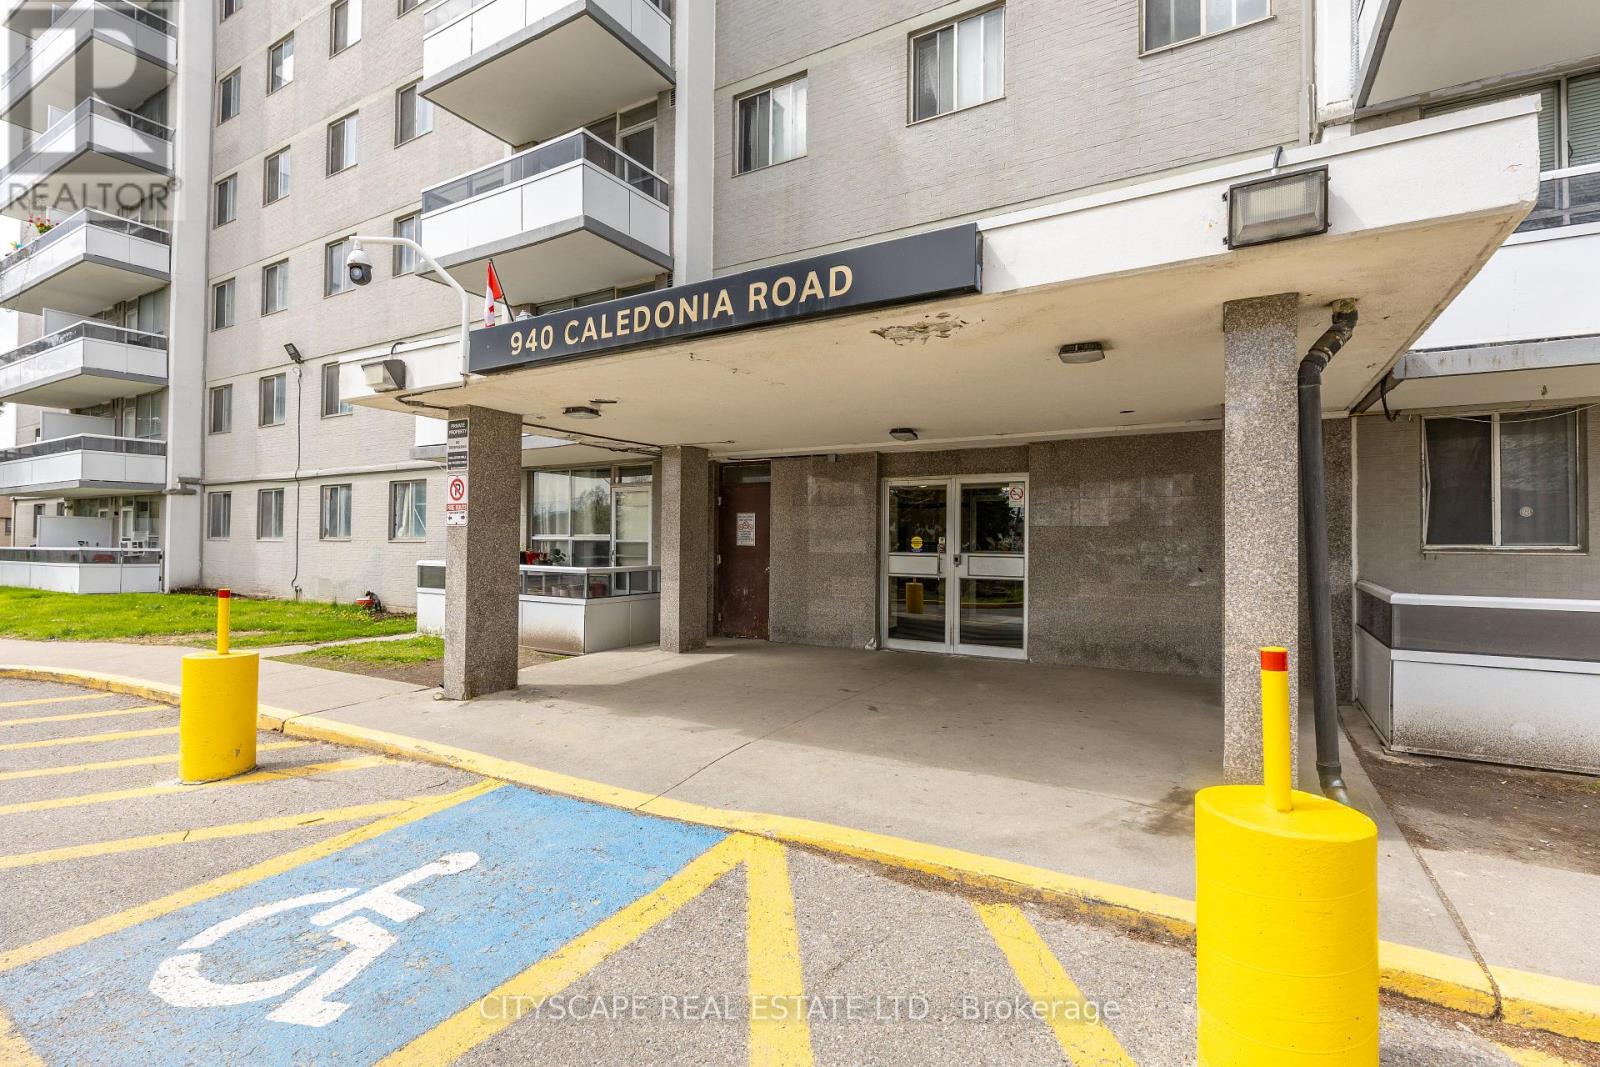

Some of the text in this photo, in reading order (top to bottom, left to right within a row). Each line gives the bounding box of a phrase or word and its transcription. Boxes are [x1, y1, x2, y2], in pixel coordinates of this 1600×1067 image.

[510, 265, 853, 356] 940 CALEDONIA ROAD
